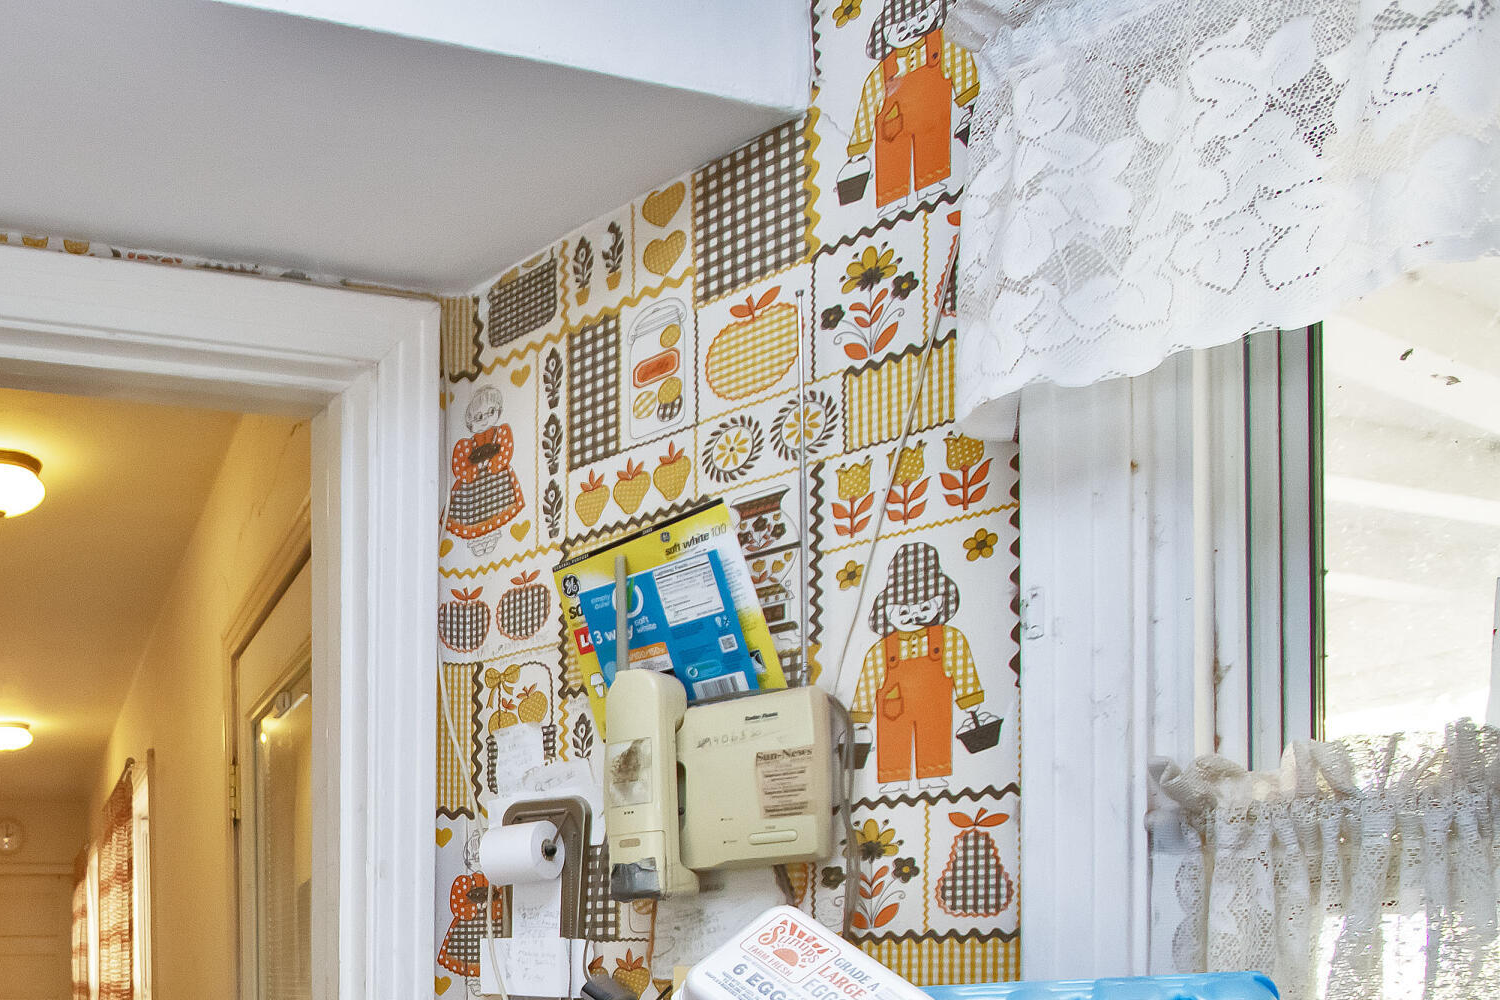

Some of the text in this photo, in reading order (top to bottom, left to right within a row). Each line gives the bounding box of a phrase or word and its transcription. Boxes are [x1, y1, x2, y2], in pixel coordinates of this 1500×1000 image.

[682, 531, 710, 549] white
[711, 524, 727, 538] 100
[568, 603, 584, 620] so
[593, 624, 634, 645] 3 wy
[756, 748, 812, 761] Sun-News
[732, 963, 749, 976] 6
[747, 944, 794, 977] FARM FRESH
[818, 965, 868, 1000] LARGE
[833, 957, 881, 992] GRADE A
